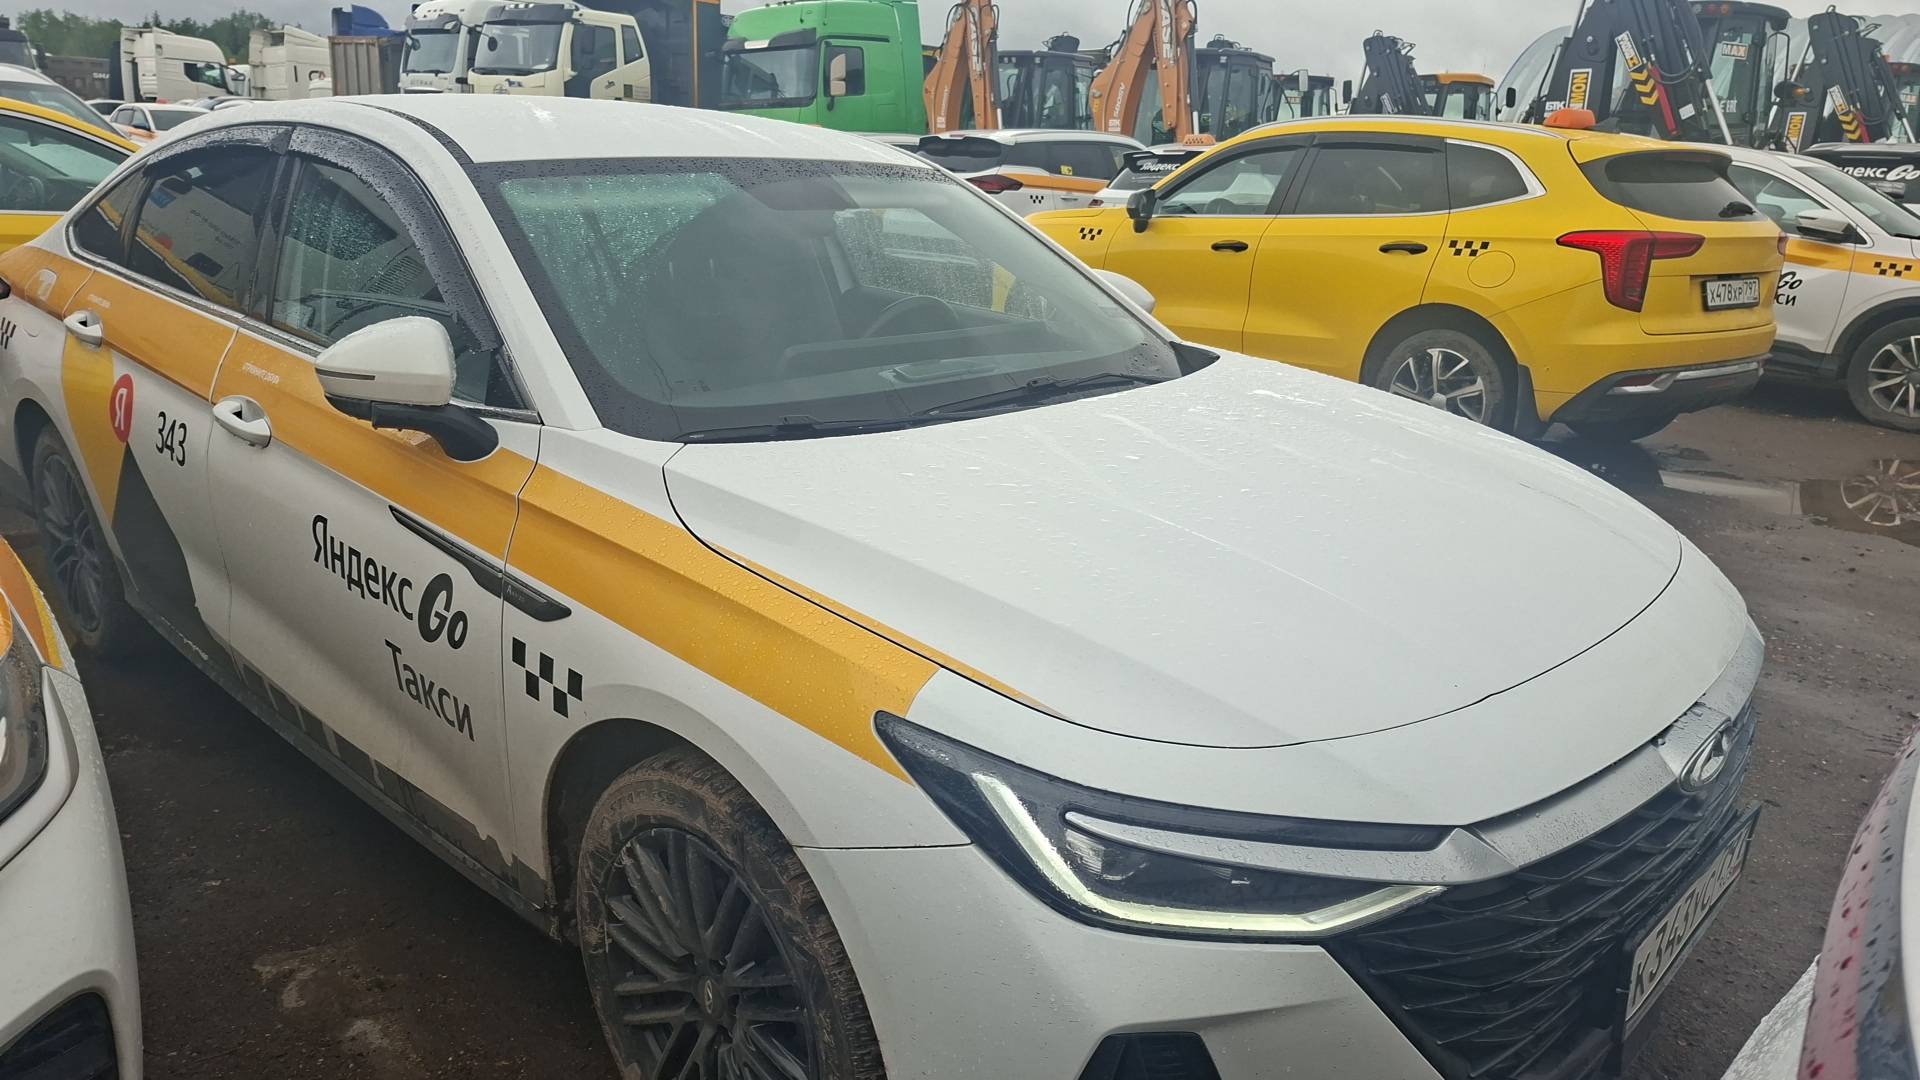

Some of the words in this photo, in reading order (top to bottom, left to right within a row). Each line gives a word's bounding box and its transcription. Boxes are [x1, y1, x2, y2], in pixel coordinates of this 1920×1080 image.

[1774, 293, 1797, 307] си
[156, 410, 188, 467] 343
[311, 514, 414, 621] Яндекс
[417, 572, 469, 650] Go
[384, 639, 476, 743] Такси
